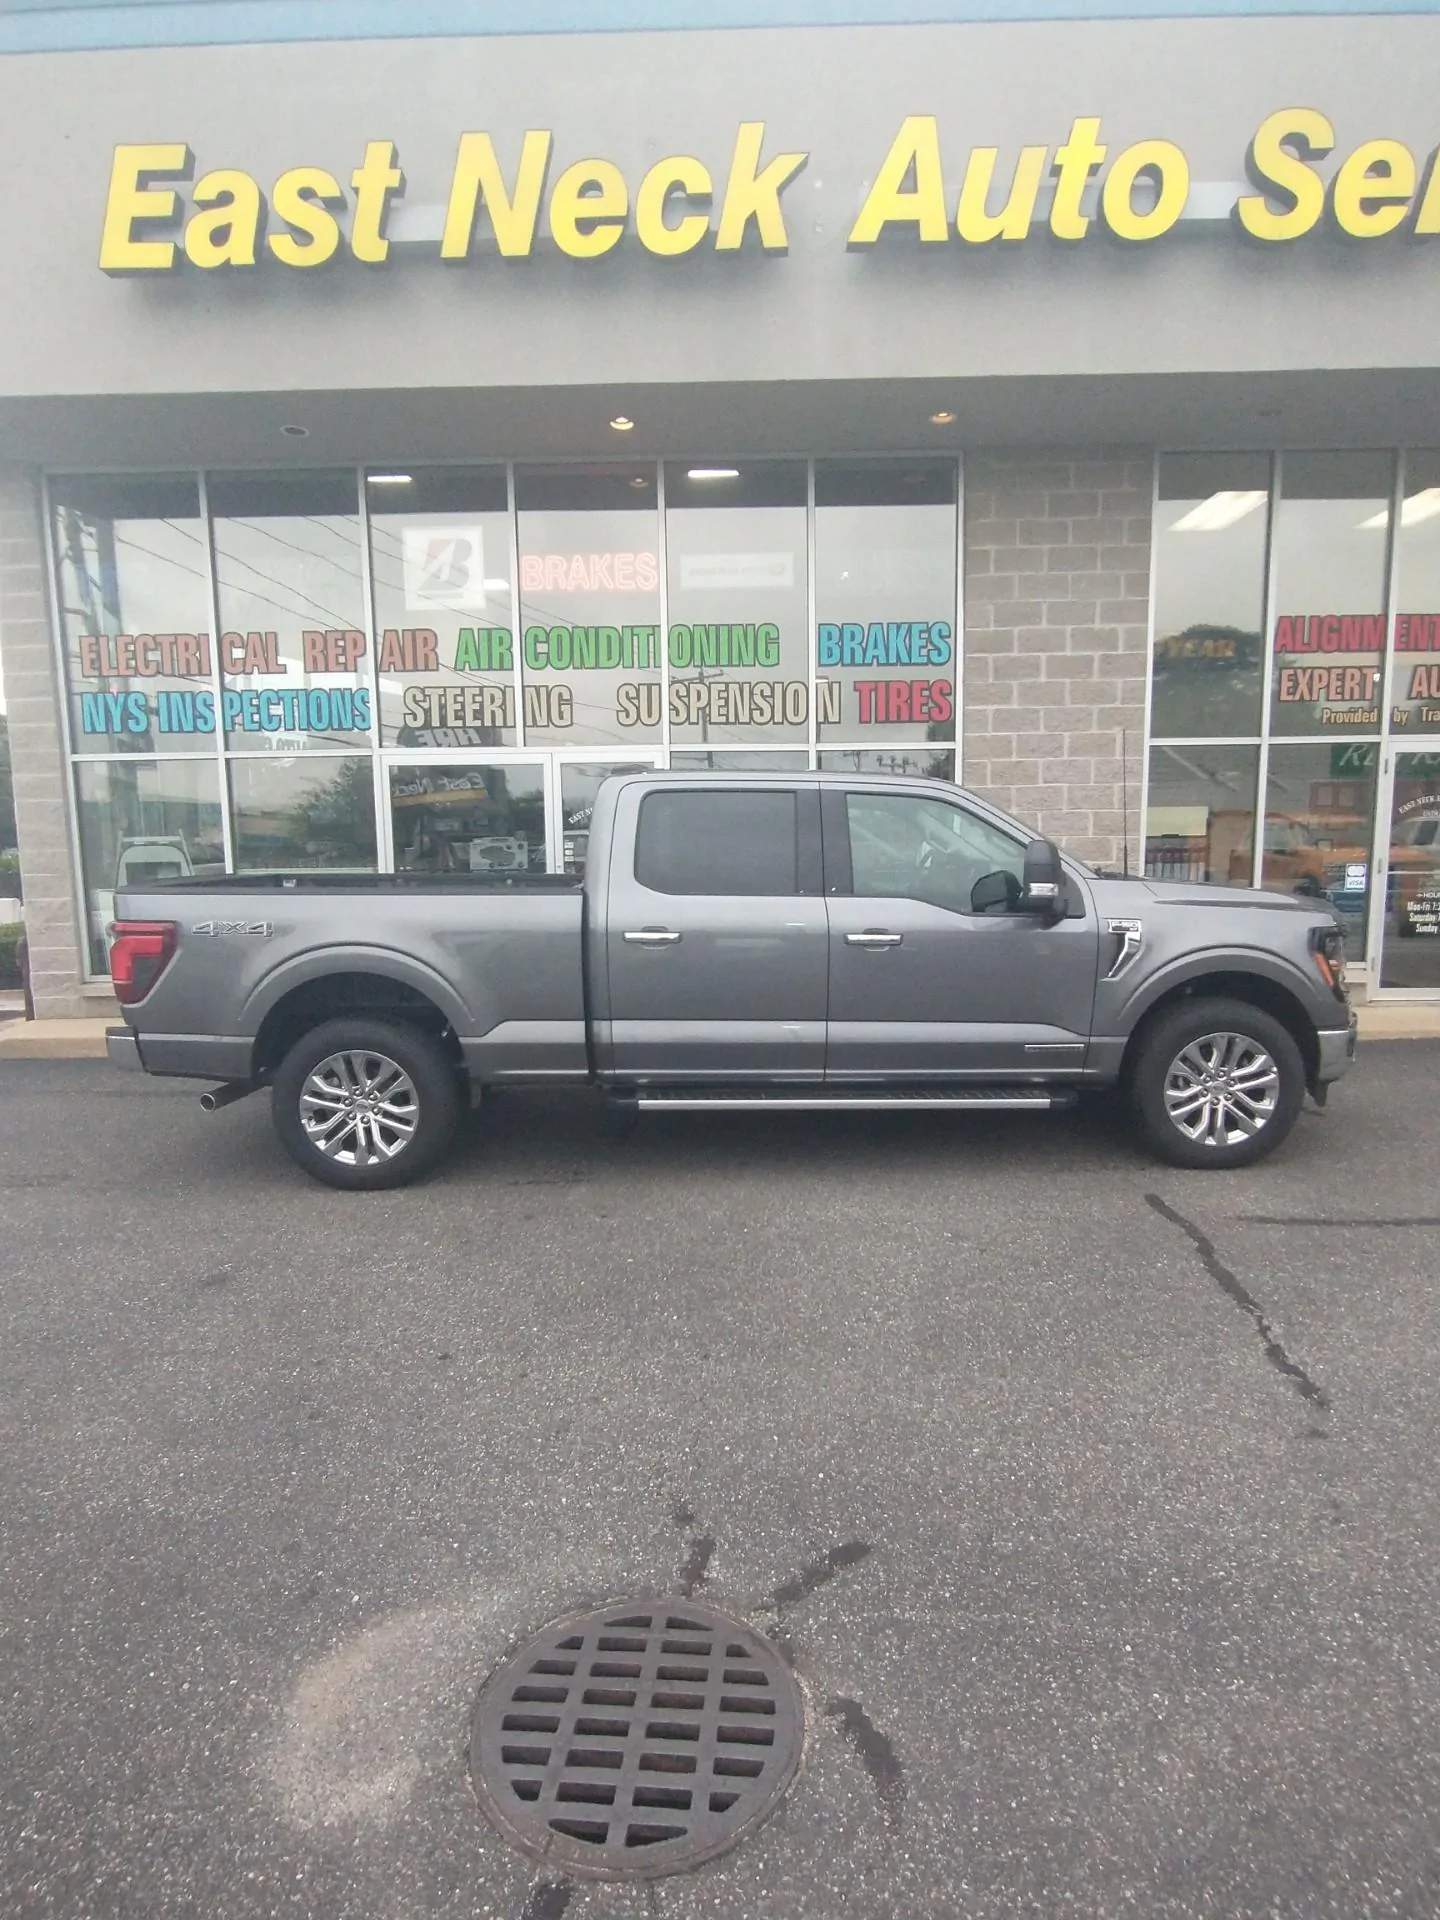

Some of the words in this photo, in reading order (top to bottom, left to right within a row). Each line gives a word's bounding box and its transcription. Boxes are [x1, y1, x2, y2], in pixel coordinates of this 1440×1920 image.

[98, 140, 402, 270] East
[440, 120, 810, 259] Neck
[846, 115, 1191, 247] Auto
[519, 551, 659, 592] BRAKES
[79, 631, 288, 678] ELECTRICAL
[303, 628, 439, 674] REPAIR
[454, 626, 514, 671] AIR
[524, 623, 780, 671] CONDITIONING
[818, 621, 952, 667] BRAKES
[403, 684, 574, 729] STEERING
[616, 680, 842, 726] SUSPENSION
[853, 679, 953, 725] TIRES
[1280, 666, 1380, 702] EXPERT
[80, 691, 149, 734] NYS
[157, 687, 372, 734] INSPECTIONS
[1321, 706, 1379, 725] Provided
[1393, 706, 1410, 726] by
